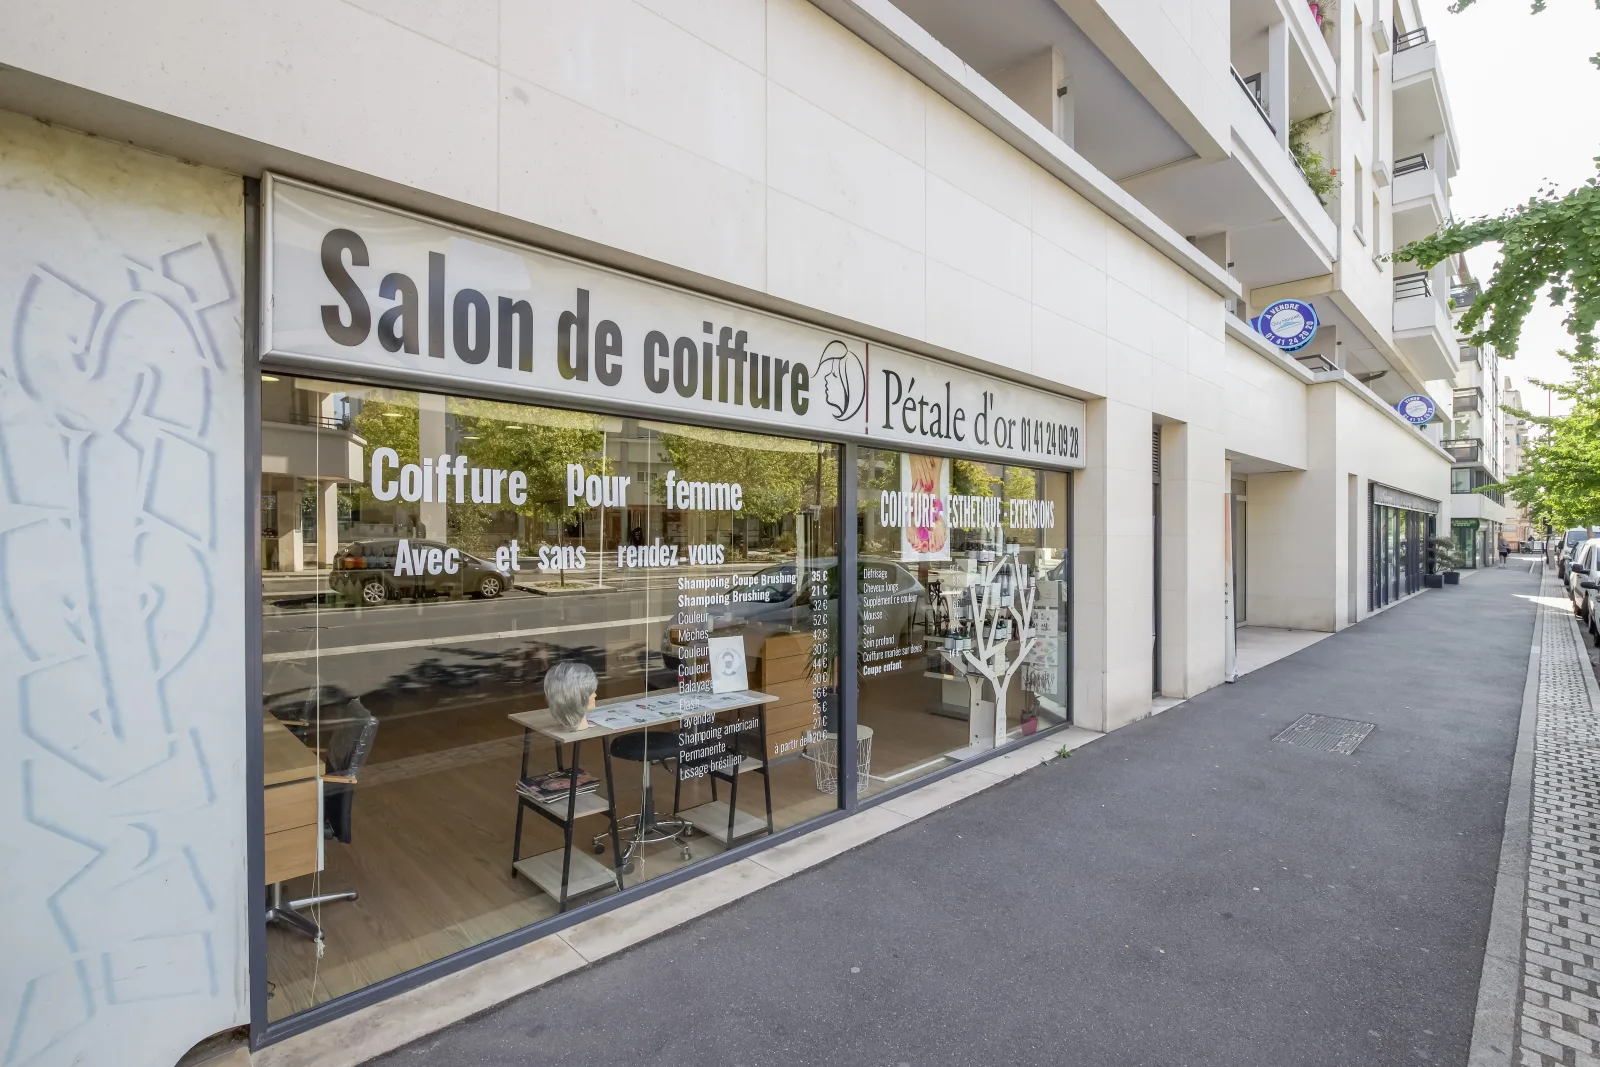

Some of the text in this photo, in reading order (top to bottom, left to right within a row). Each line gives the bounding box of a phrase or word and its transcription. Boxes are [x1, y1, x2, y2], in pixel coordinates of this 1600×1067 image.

[1269, 303, 1300, 314] VENDRE
[320, 228, 809, 416] Salon de coiffure
[1265, 332, 1275, 341] 01
[1288, 337, 1299, 345] 24
[1299, 331, 1309, 340] 20
[1305, 321, 1314, 330] 20
[882, 369, 1079, 459] Pétale d'or 01 41 24 09 28
[371, 447, 528, 506] Coiffure
[665, 469, 743, 511] femme
[880, 489, 936, 528] COIFFURE
[947, 495, 1002, 531] ESTHETIQUE
[1009, 499, 1055, 529] EXTENSIONS
[394, 538, 460, 577] Avec
[496, 539, 521, 571] et
[538, 541, 587, 571] sans
[678, 572, 796, 590] Shampoing Coupe Brushing
[811, 571, 821, 582] 35
[811, 586, 821, 597] 21
[863, 582, 899, 594] Cheveux longs
[678, 589, 770, 607] Shampoing Brushing
[863, 594, 893, 608] Supplément
[900, 594, 918, 604] couleur
[813, 601, 821, 611] 32
[678, 611, 709, 625] Couleur
[813, 615, 821, 626] 52
[863, 610, 883, 621] Mousse
[678, 628, 709, 643] Mèches
[813, 629, 821, 640] 42
[863, 624, 875, 635] Soin
[863, 634, 895, 649] Soin profond
[678, 646, 709, 660] Couleur
[813, 644, 821, 655] 30
[863, 644, 923, 663] Coiffure mariée sur devis
[678, 663, 709, 677] Couleur
[813, 658, 821, 669] 44
[863, 660, 902, 676] Coupe enfant
[813, 673, 821, 684] 30
[679, 680, 713, 695] Balayage
[813, 688, 821, 699] 56
[813, 703, 821, 715] 25
[678, 717, 759, 747] Shampoing américain
[774, 743, 779, 754] à
[780, 739, 798, 754] partir
[800, 735, 807, 747] de
[679, 741, 726, 764] Permanente
[679, 753, 742, 781] Lissage brésilien
